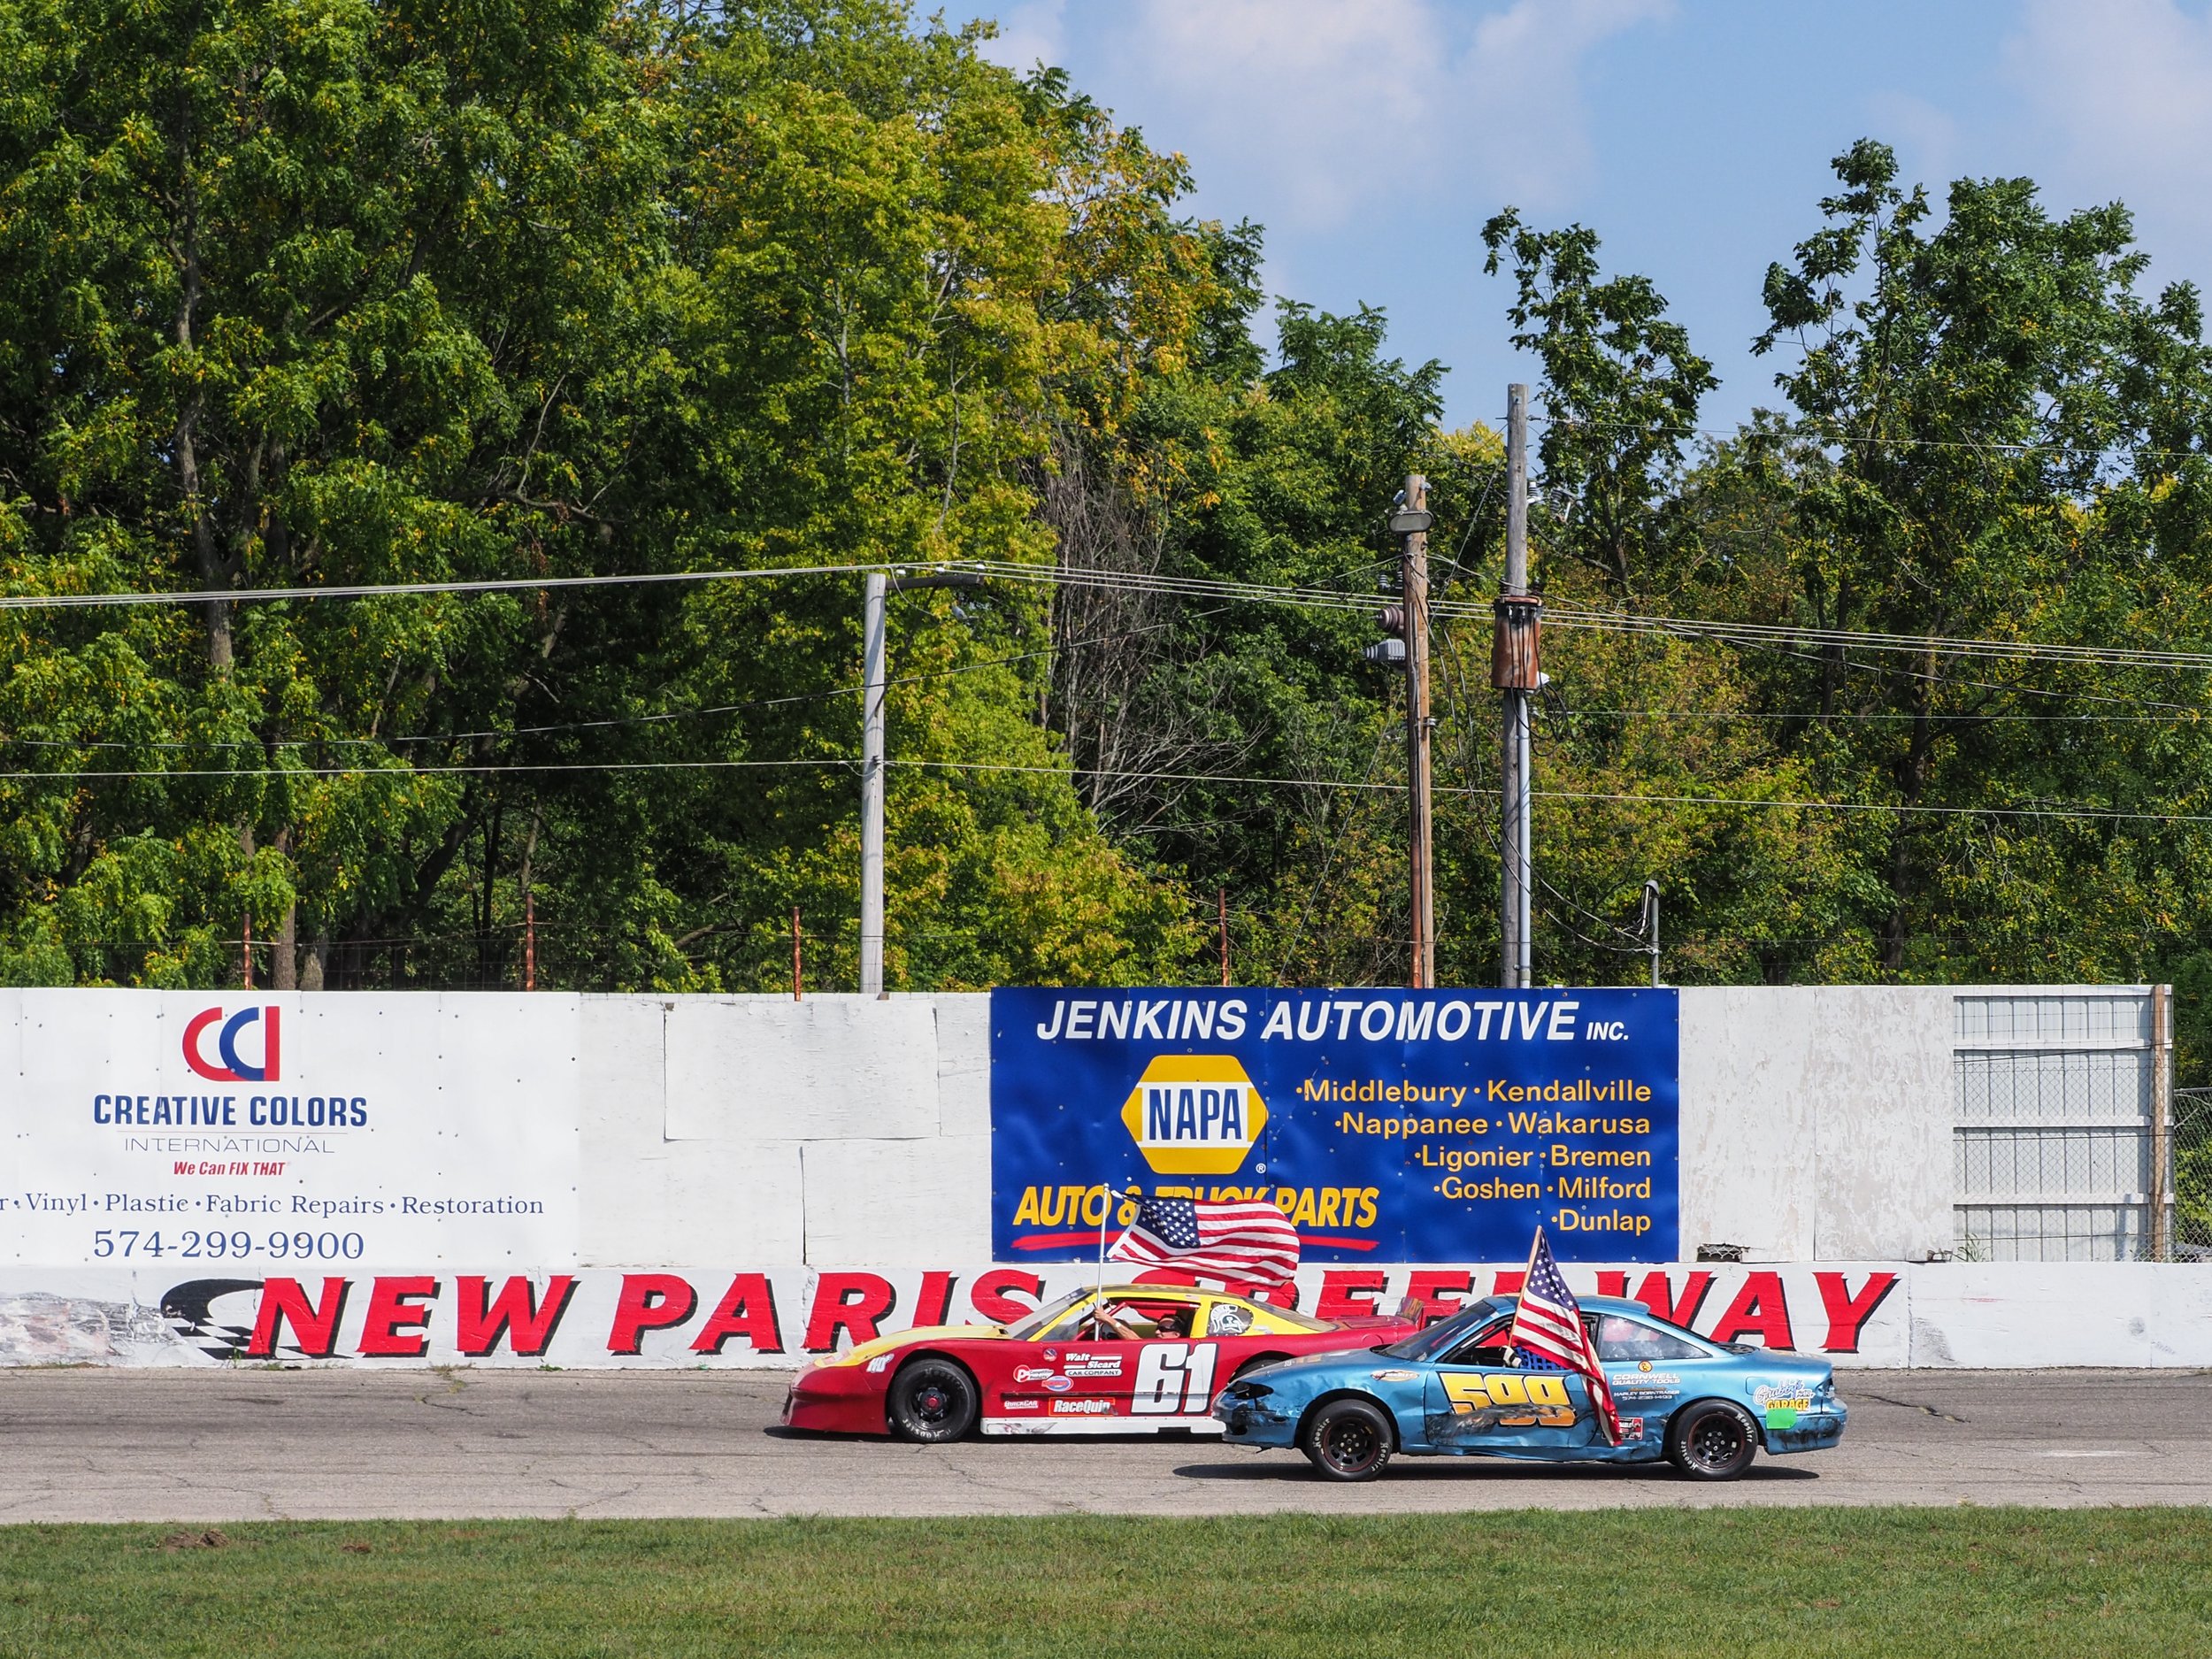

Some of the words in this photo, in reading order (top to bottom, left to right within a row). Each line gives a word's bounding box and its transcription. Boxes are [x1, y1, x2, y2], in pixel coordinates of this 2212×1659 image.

[1036, 1000, 1247, 1041] JENKINS
[1260, 1000, 1579, 1041] AUTOMOTIVE
[1586, 1021, 1630, 1041] INC.
[1304, 1079, 1466, 1104] Middlebury
[1488, 1079, 1652, 1102] Kendallville
[94, 1094, 237, 1126] CREATIVE
[250, 1095, 368, 1128] COLORS
[1148, 1088, 1242, 1141] NAPA
[1343, 1112, 1488, 1139] Nappanee
[1509, 1113, 1651, 1135] Wakarusa
[125, 1138, 335, 1154] INTERNATIONAL
[1423, 1145, 1532, 1171] Ligonier
[1551, 1145, 1652, 1168] Bremen
[173, 1161, 196, 1176] We
[200, 1161, 227, 1176] Can
[229, 1162, 250, 1177] FIX
[253, 1162, 286, 1177] THAT
[1442, 1176, 1540, 1200] Goshen
[1551, 1176, 1652, 1200] Milford
[25, 1193, 88, 1217] Vinyl
[105, 1193, 189, 1212] Plastic
[206, 1194, 282, 1214] Fabric
[291, 1195, 385, 1219] Repairs
[402, 1194, 545, 1216] Restoration
[1012, 1186, 1111, 1226] AUTO
[1117, 1186, 1142, 1226] &
[1272, 1187, 1380, 1228] PARTS
[1559, 1209, 1652, 1235] Dunlap
[94, 1228, 365, 1260] 574-299-9900
[246, 1275, 582, 1359] NEW
[605, 1269, 1046, 1356] PARIS
[1064, 1353, 1092, 1362] Walt
[1130, 1342, 1217, 1414] 61
[1613, 1372, 1679, 1381] CORNWELL
[1766, 1399, 1809, 1411] GARAGE
